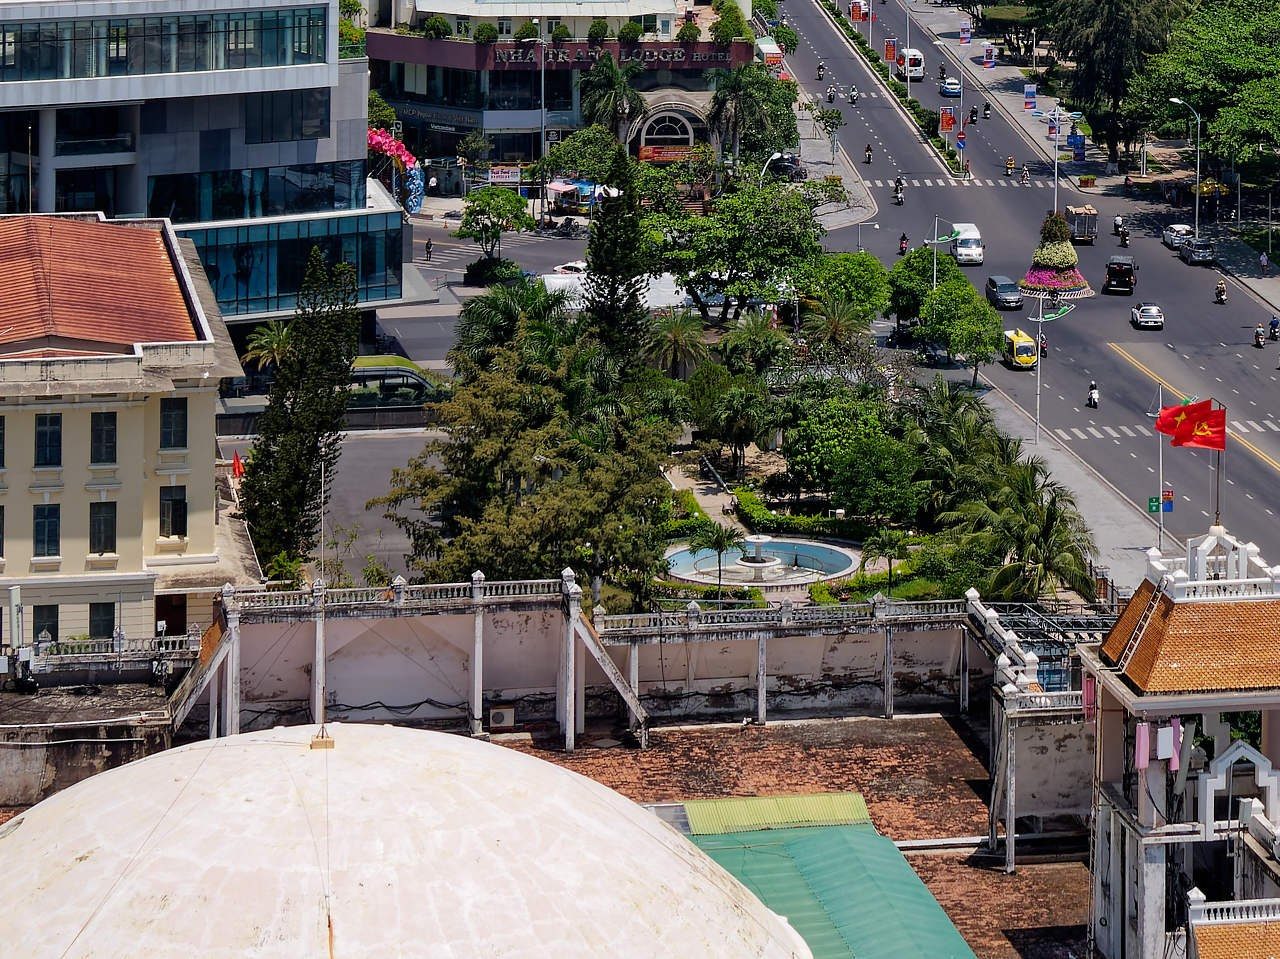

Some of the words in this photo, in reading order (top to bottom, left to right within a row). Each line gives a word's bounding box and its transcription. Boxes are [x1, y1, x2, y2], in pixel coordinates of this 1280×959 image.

[495, 48, 537, 62] NHA
[545, 48, 612, 62] TRA
[619, 47, 686, 62] LODGE
[692, 51, 732, 62] HOTEL
